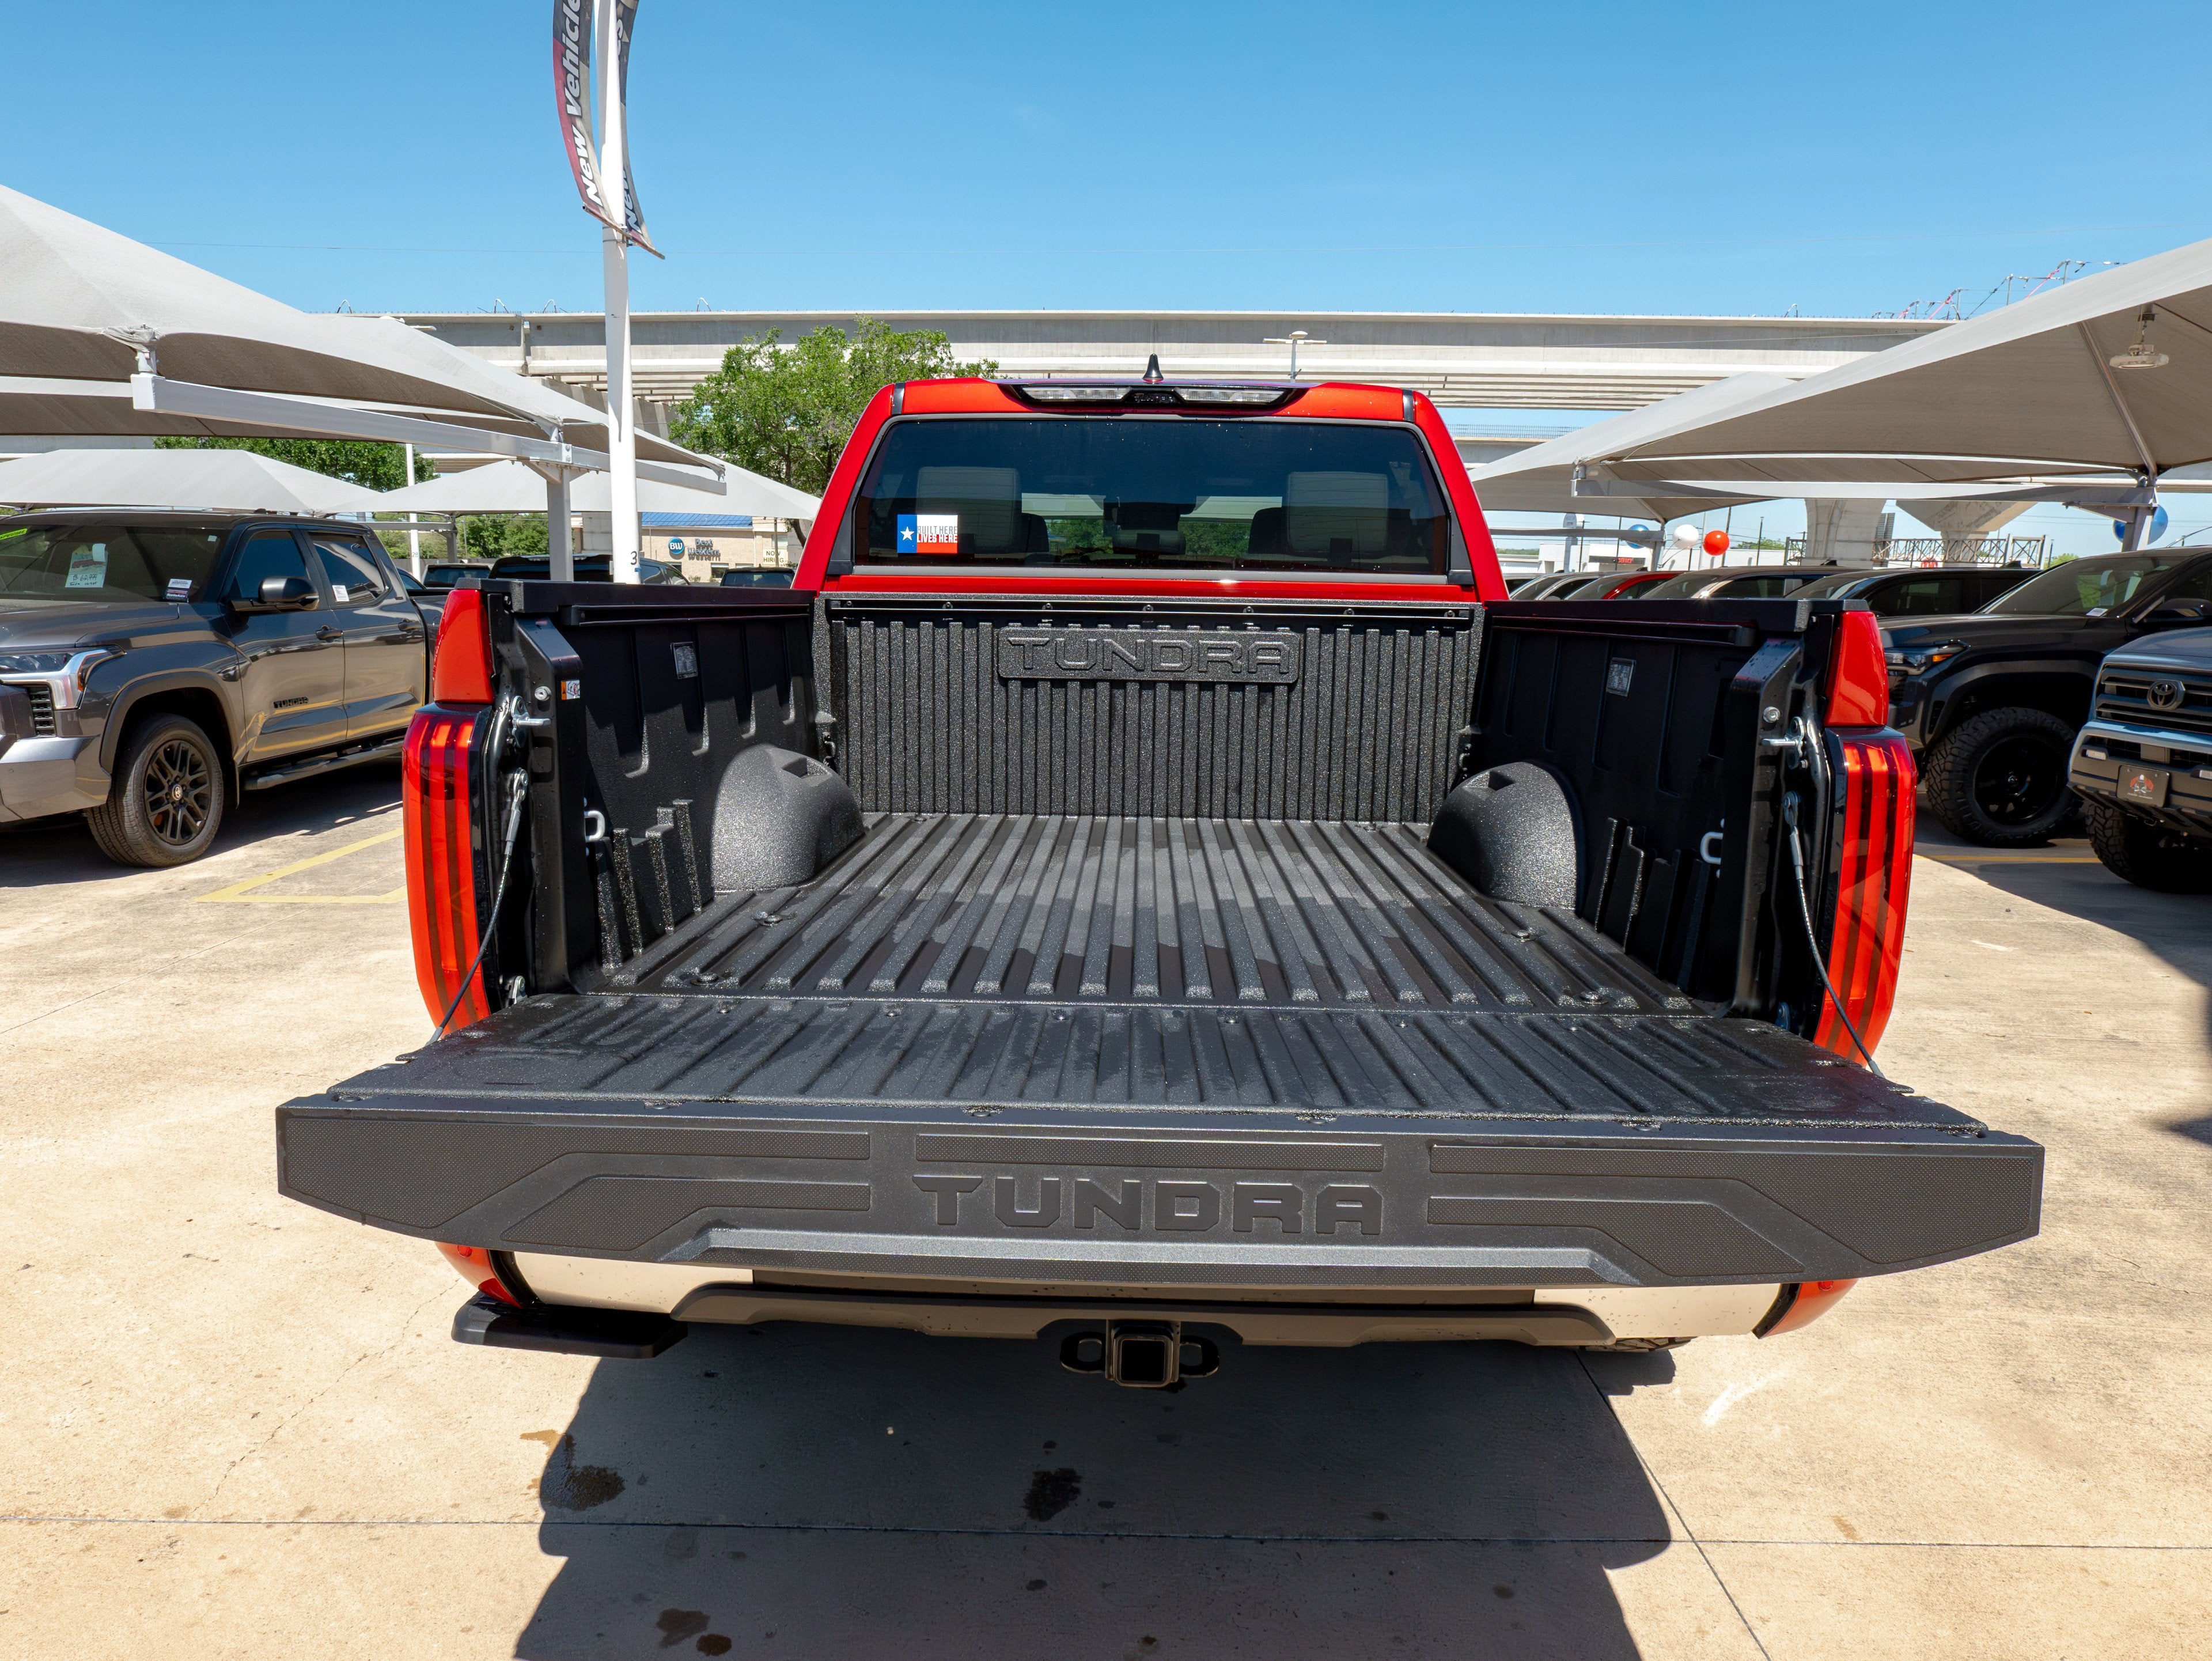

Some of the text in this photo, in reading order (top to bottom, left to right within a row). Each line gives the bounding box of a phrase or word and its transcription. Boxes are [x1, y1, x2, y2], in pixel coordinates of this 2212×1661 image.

[572, 124, 603, 207] New
[917, 525, 957, 535] BUILT HERE
[917, 534, 957, 543] LIVES HERE
[670, 542, 683, 550] BW
[631, 551, 637, 565] 3
[1007, 637, 1290, 674] TUNDRA
[912, 1175, 1382, 1235] TUNDRA
